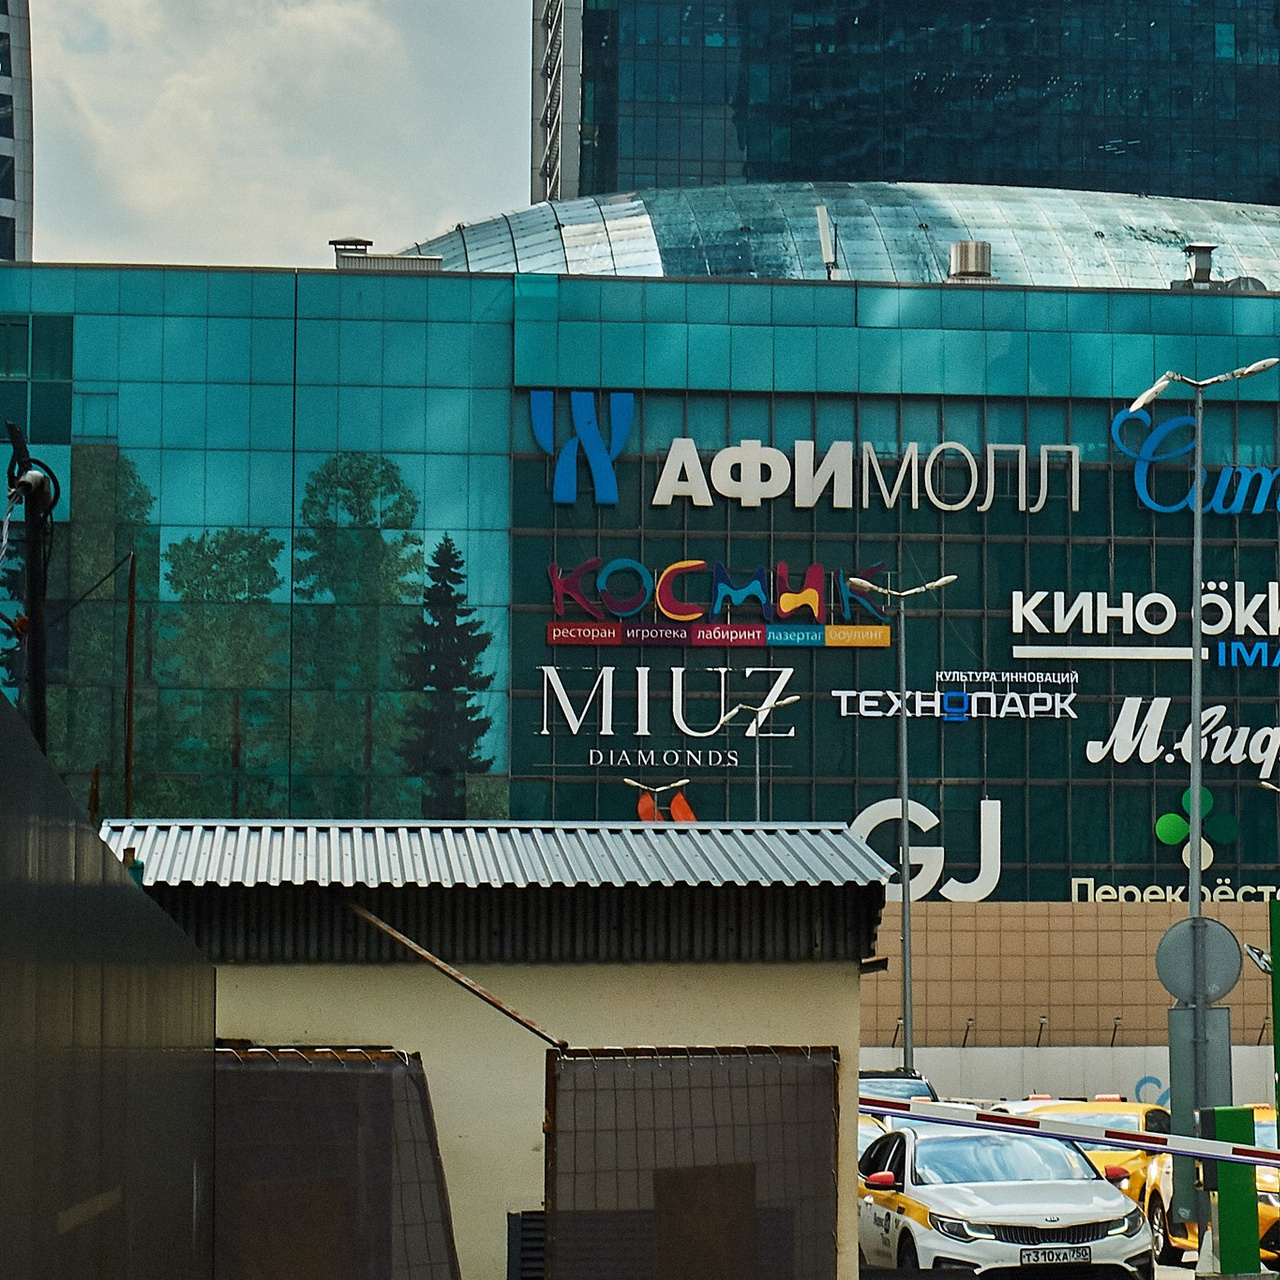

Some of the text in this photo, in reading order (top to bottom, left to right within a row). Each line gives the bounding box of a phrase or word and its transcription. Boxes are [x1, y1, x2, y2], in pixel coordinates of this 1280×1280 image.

[651, 437, 1081, 513] АФИМОЛЛ
[548, 557, 891, 623] КОСМИК
[1012, 591, 1177, 635] КИНО
[552, 627, 884, 644] ресторан игротека лабиринт лазертаг боулинг
[935, 669, 1079, 685] КУЛЬТУРА ИННОВАЦИЙ
[540, 666, 795, 737] MIUZ
[831, 690, 1079, 721] ТЕХНОПАРК
[589, 749, 740, 767] DIAMONDS
